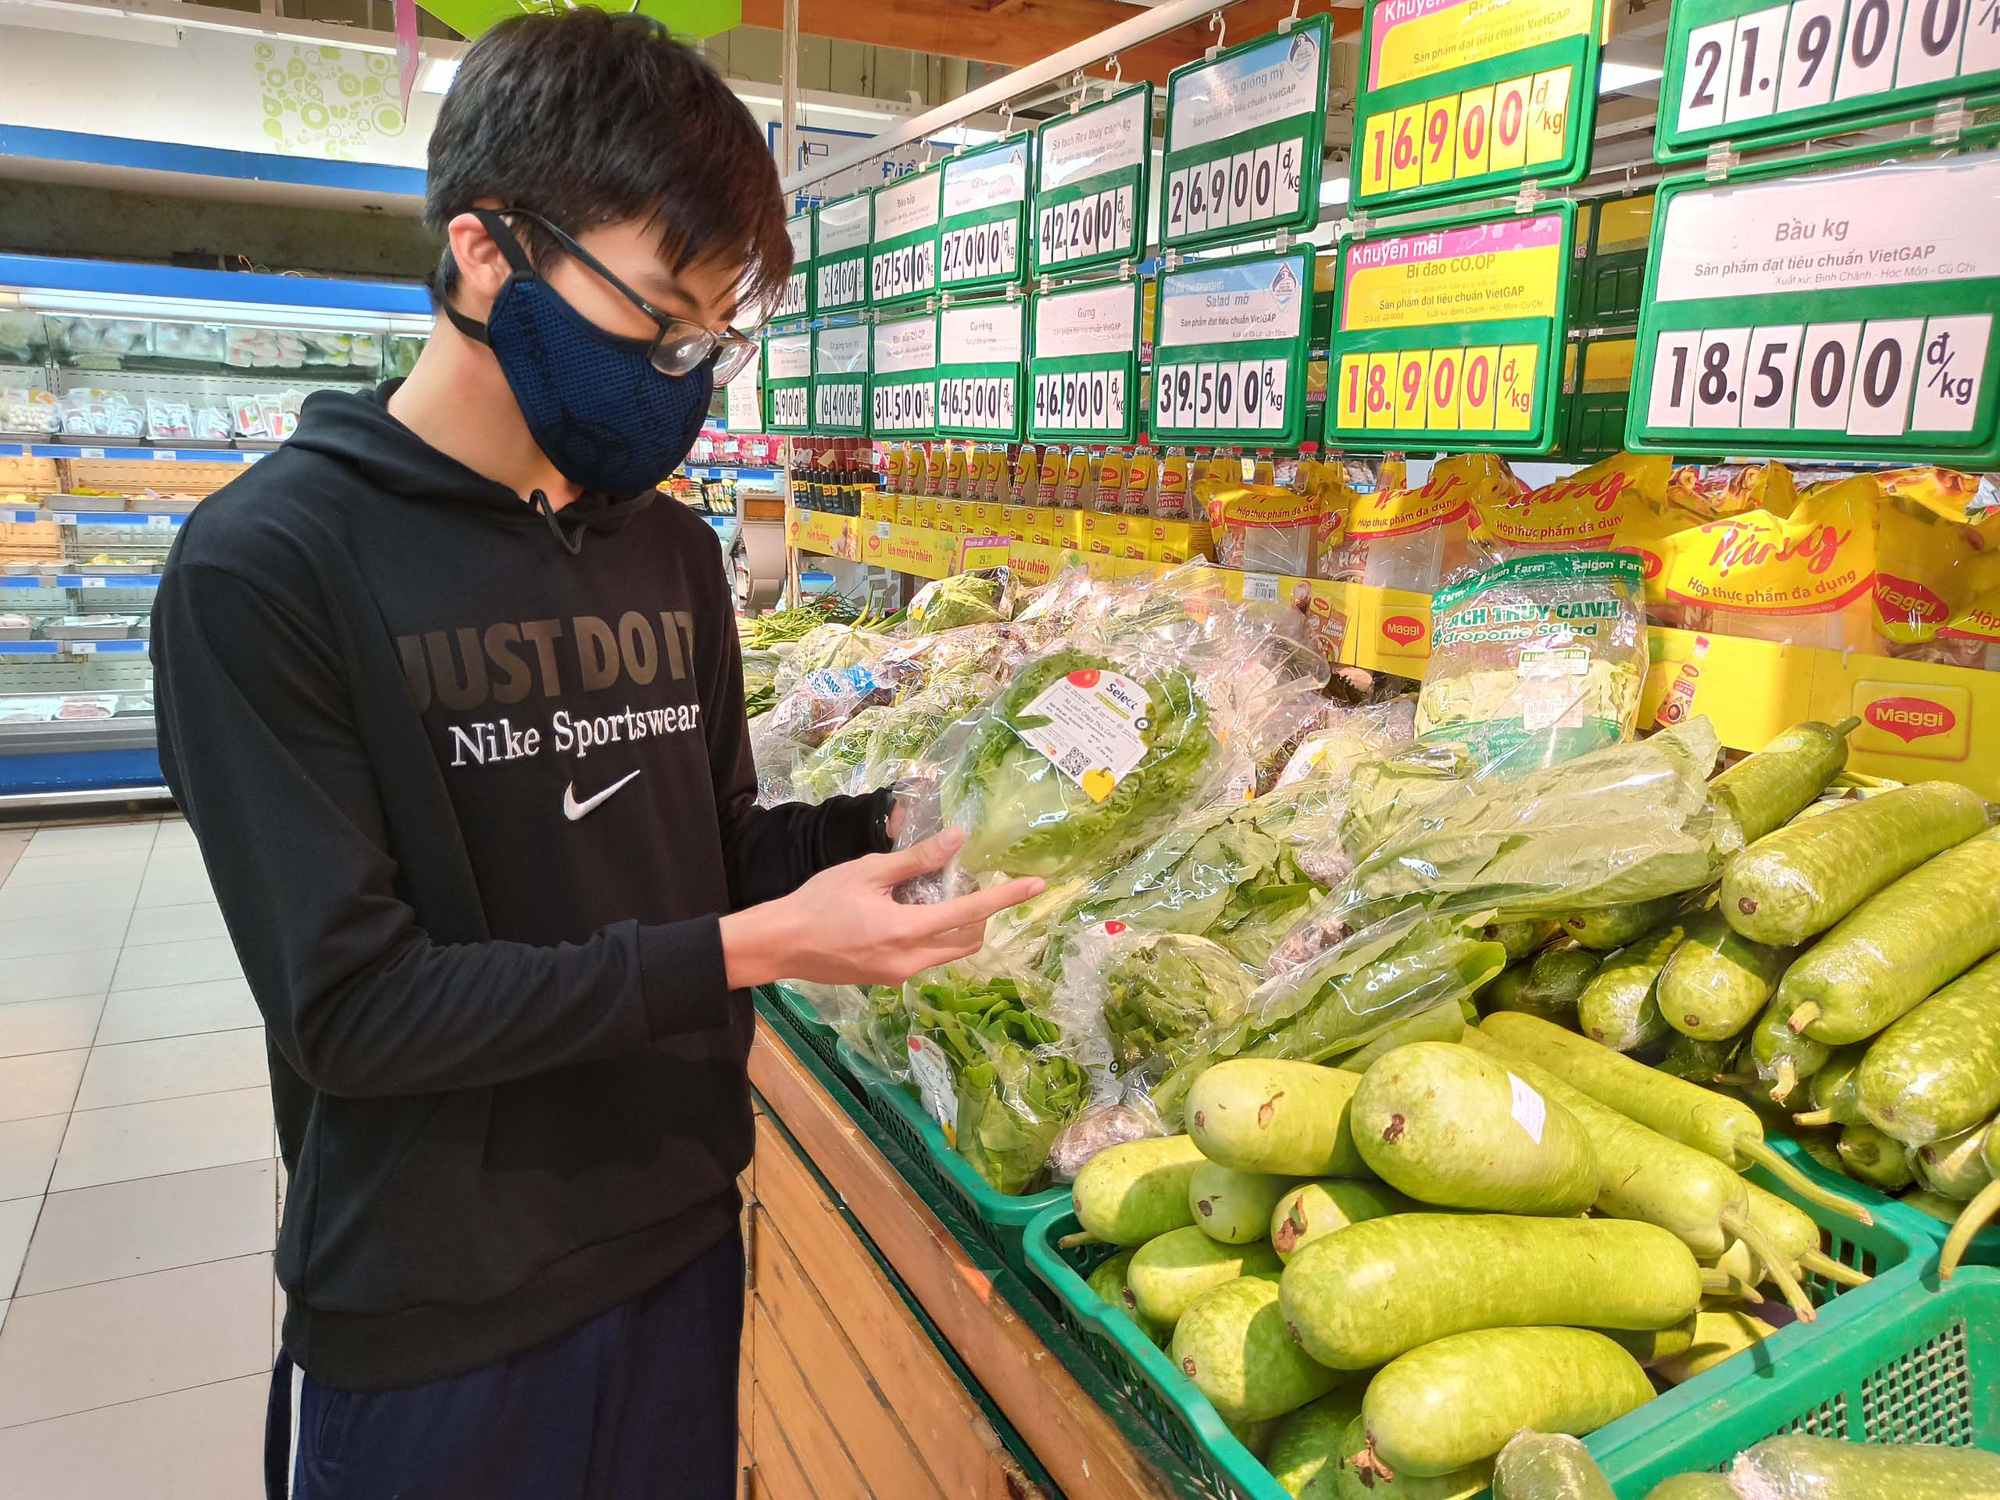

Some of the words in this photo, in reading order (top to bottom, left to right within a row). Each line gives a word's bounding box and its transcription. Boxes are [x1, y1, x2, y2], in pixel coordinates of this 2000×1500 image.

[1527, 8, 1570, 30] VietGAP
[1689, 0, 1959, 109] 21.900
[1269, 83, 1297, 102] VietGAP
[1374, 90, 1522, 182] 16.900
[1171, 159, 1271, 224] 26.900
[1042, 199, 1113, 251] 42.200
[1775, 217, 1815, 242] Bầu
[1822, 218, 1849, 242] kg
[943, 229, 1000, 272] 27.000
[1352, 236, 1409, 267] Khuyến
[1406, 263, 1420, 280] Bí
[1423, 260, 1447, 277] đao
[1450, 253, 1496, 273] CO.OP
[1695, 262, 1719, 277] Sản
[1722, 257, 1758, 278] phẩm
[1762, 257, 1784, 274] đạt
[1787, 256, 1814, 271] tiêu
[1817, 249, 1863, 269] chuẩn
[1869, 245, 1936, 265] VietGAP
[874, 251, 924, 292] 27.500
[1206, 294, 1230, 308] Salad
[1379, 298, 1395, 311] Sản
[1396, 293, 1419, 310] phẩm
[1421, 293, 1435, 307] đạt
[1436, 291, 1454, 305] tiêu
[1455, 288, 1483, 304] chuẩn
[1485, 285, 1525, 300] VietGAP
[1251, 313, 1277, 324] VietGAP
[1349, 355, 1489, 414] 18.900
[1502, 358, 1530, 413] đ/kg
[1669, 337, 1903, 409] 18.500
[1927, 331, 1974, 406] đ/kg
[875, 389, 922, 421] 31.500
[940, 383, 997, 420] 46.500
[1036, 379, 1104, 418] 46.900
[1160, 370, 1259, 414] 39.500
[1026, 558, 1050, 575] nhiên
[1514, 563, 1545, 575] Farm
[1572, 560, 1614, 573] Saigon
[1687, 577, 1709, 596] Hộp
[1712, 586, 1743, 603] thực
[1745, 587, 1786, 605] phẩm
[1792, 585, 1811, 599] đa
[1814, 570, 1857, 595] dụng
[1875, 580, 1938, 617] Maggi
[1556, 600, 1620, 619] CANH
[1386, 623, 1420, 637] Maggi
[1537, 622, 1598, 637] Salad
[397, 617, 564, 715] JUST
[572, 610, 658, 692] DO
[660, 610, 696, 681] IT
[1875, 707, 1944, 728] Maggi
[448, 718, 542, 767] Nike
[552, 703, 700, 758] Sportswear
